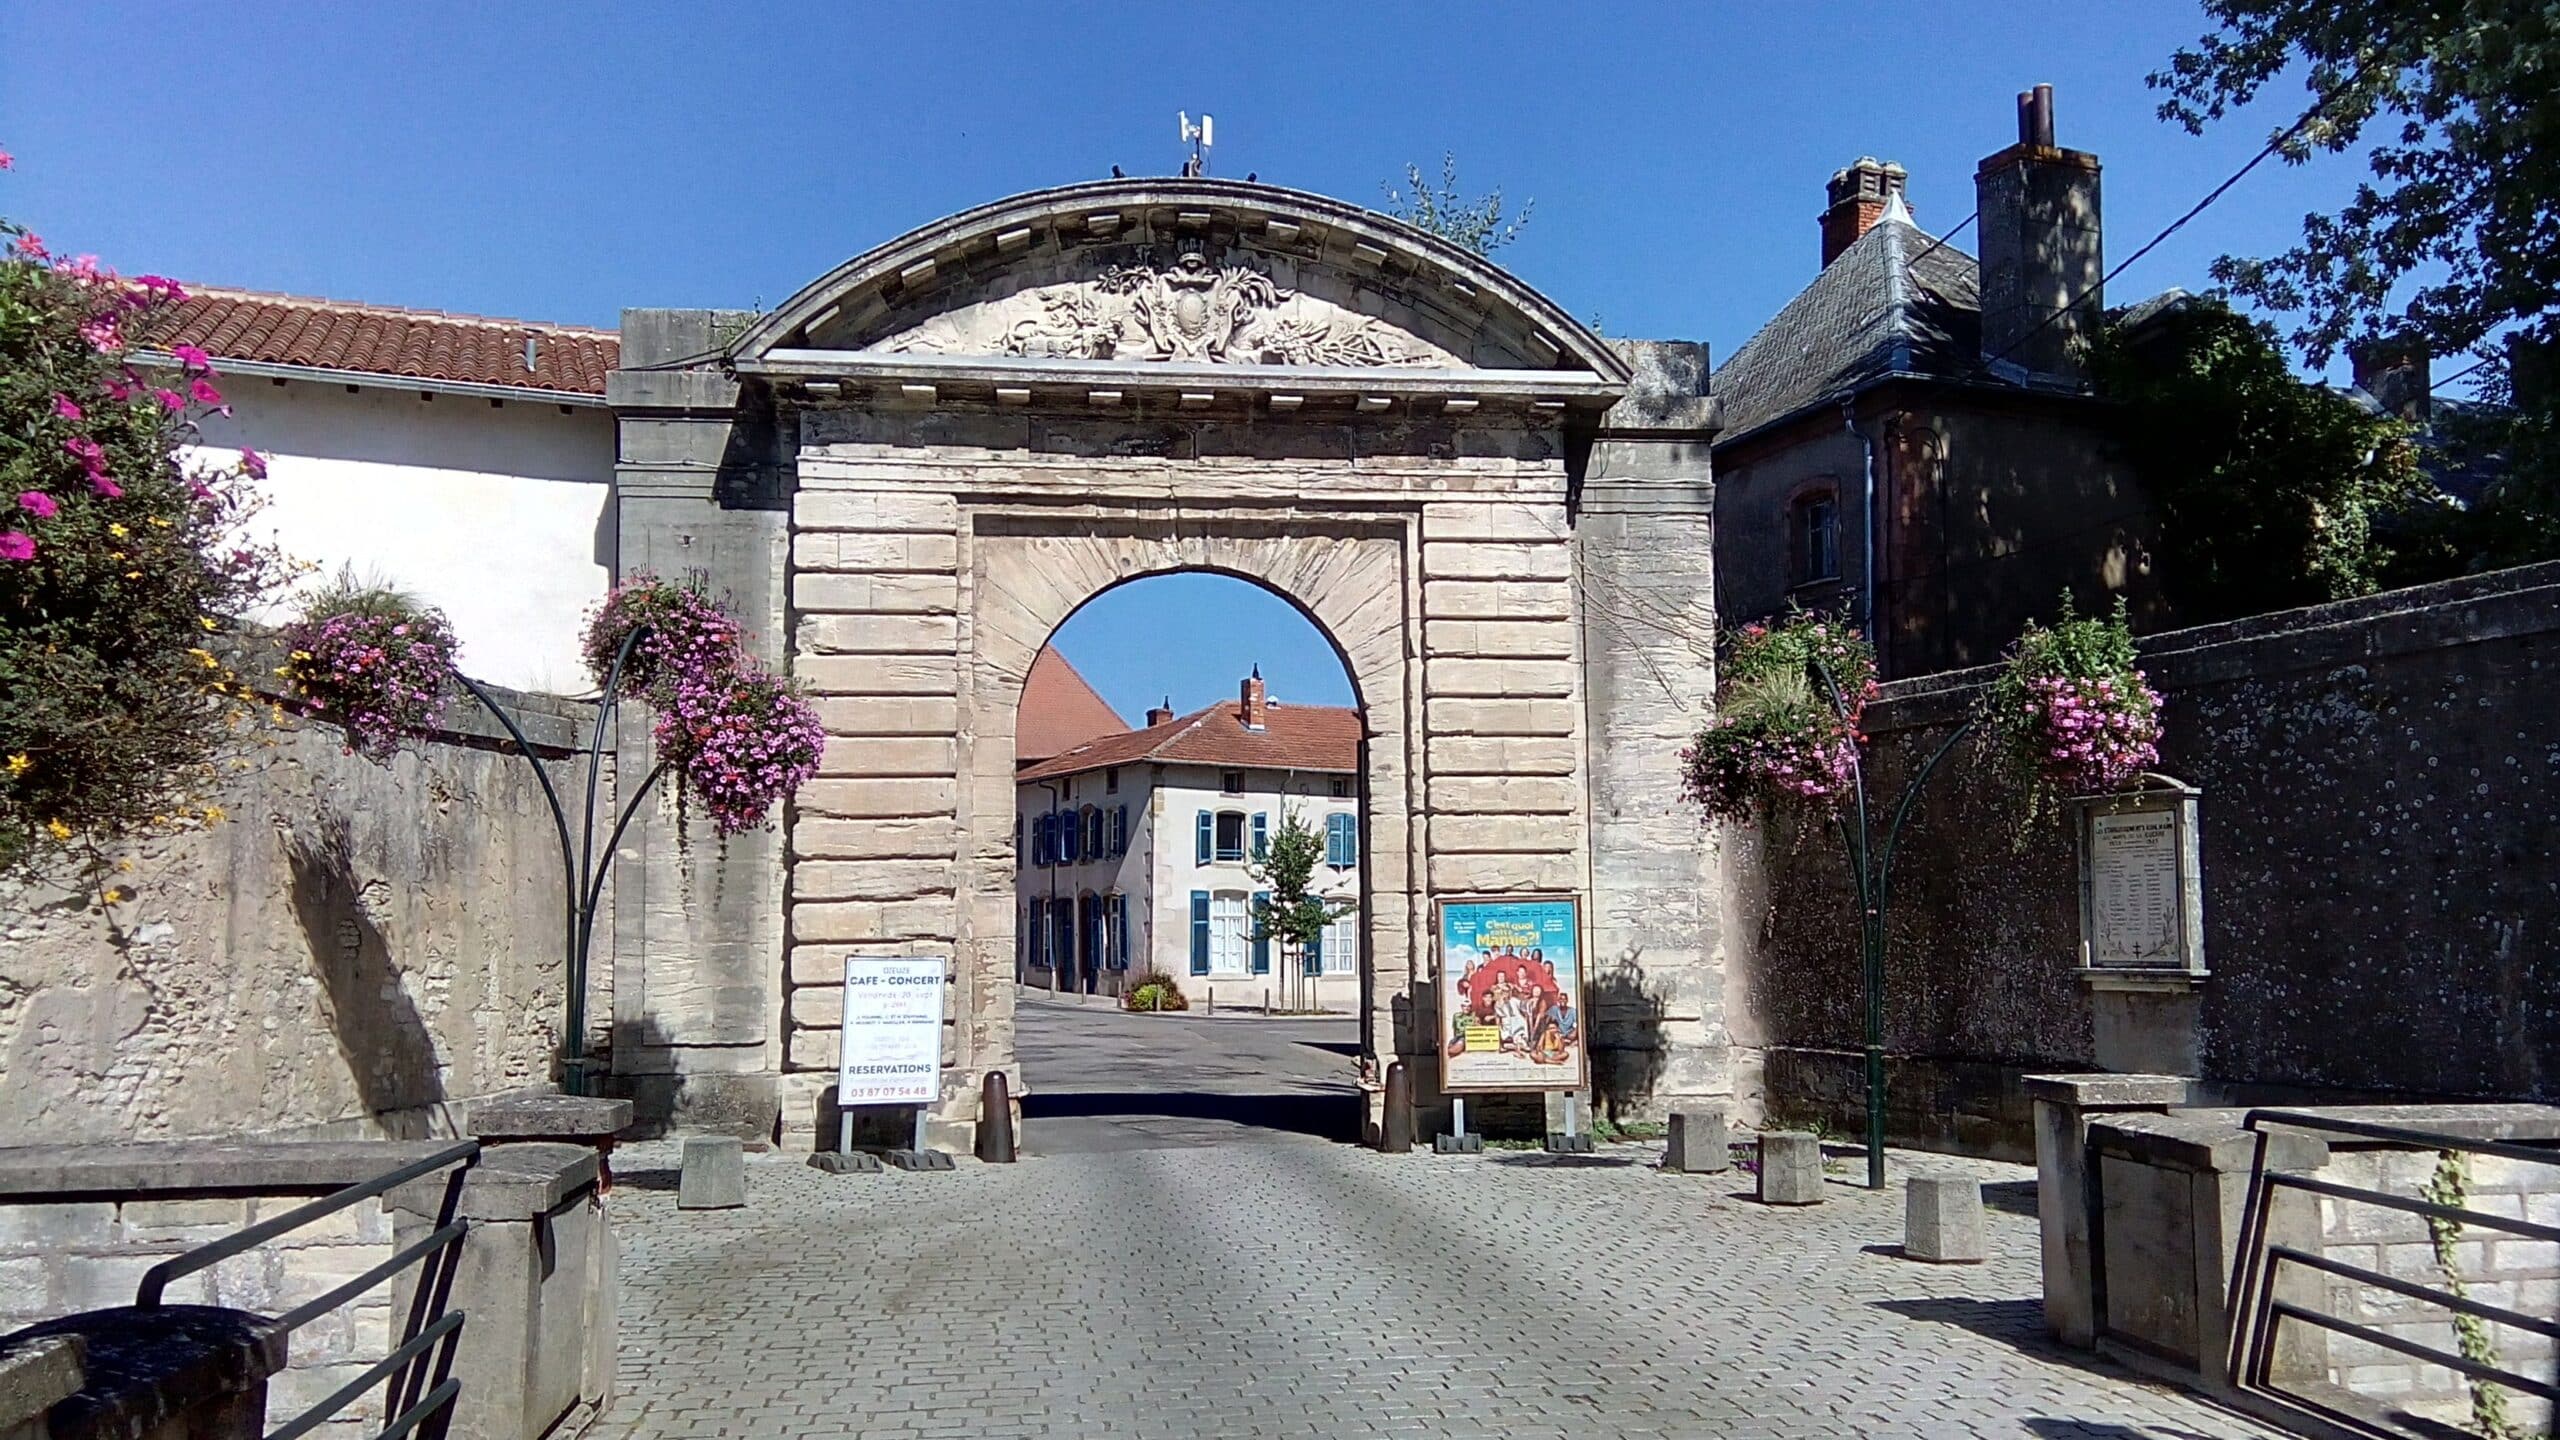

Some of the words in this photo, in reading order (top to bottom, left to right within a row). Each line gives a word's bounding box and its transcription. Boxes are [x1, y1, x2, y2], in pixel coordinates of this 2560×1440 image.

[850, 976, 878, 985] CAFE
[888, 976, 941, 985] CONCERT
[849, 1064, 931, 1075] RESERVATIONS
[851, 1088, 864, 1097] 03
[867, 1088, 880, 1097] 87
[883, 1087, 895, 1096] 07
[898, 1087, 910, 1096] 54
[914, 1086, 927, 1095] 48
